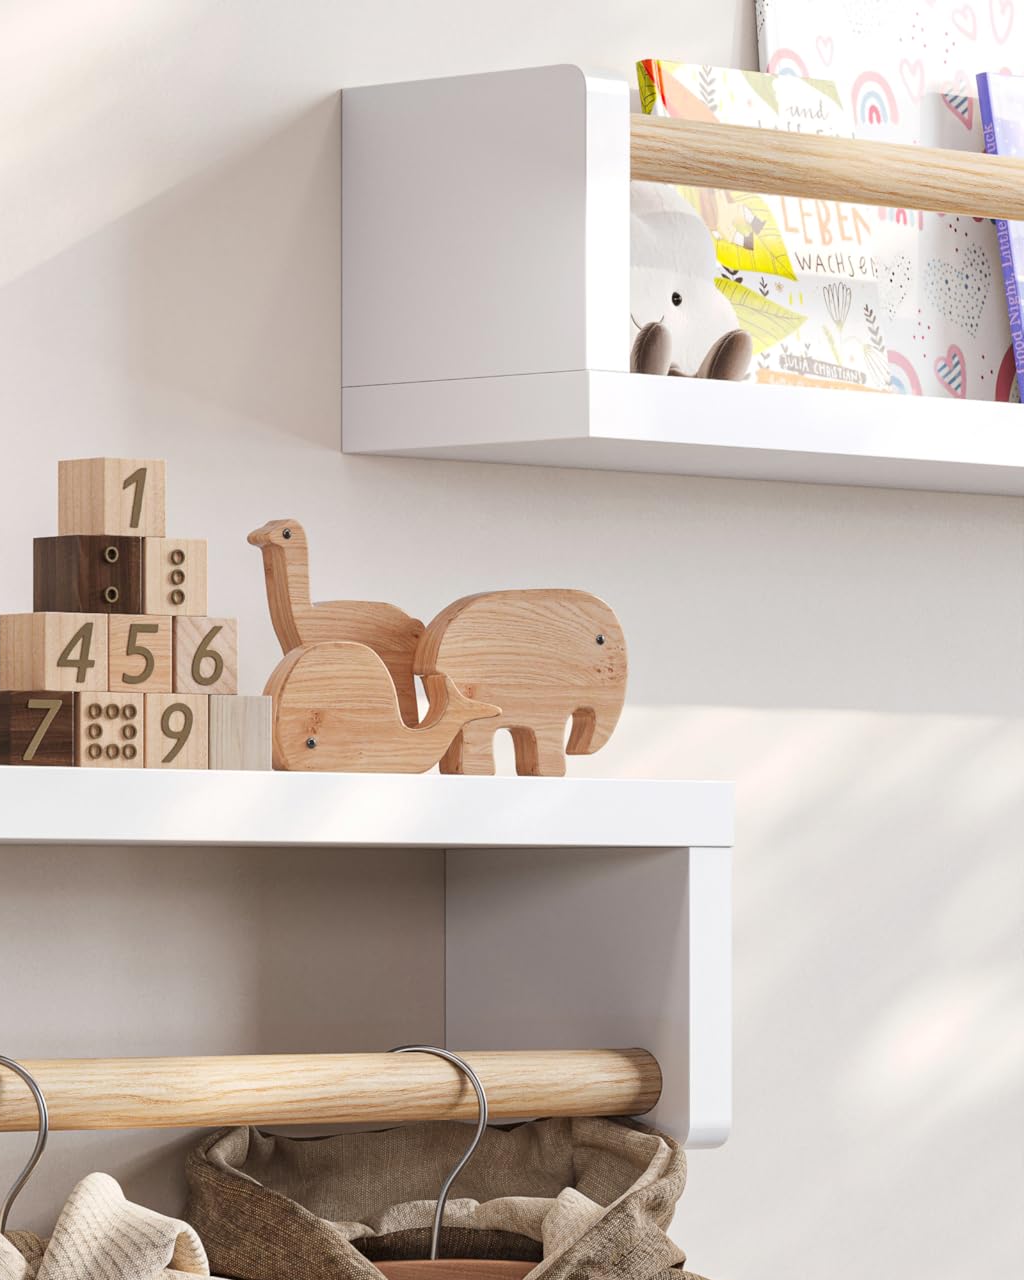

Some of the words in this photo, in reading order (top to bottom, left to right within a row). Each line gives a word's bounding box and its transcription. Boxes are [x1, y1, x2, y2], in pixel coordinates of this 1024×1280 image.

[786, 99, 829, 120] und
[997, 220, 1013, 268] Little
[122, 467, 147, 529] 1
[56, 622, 95, 683] 4
[121, 623, 159, 685] 5
[191, 625, 224, 687] 6
[22, 699, 63, 761] 7
[160, 702, 194, 763] 9
